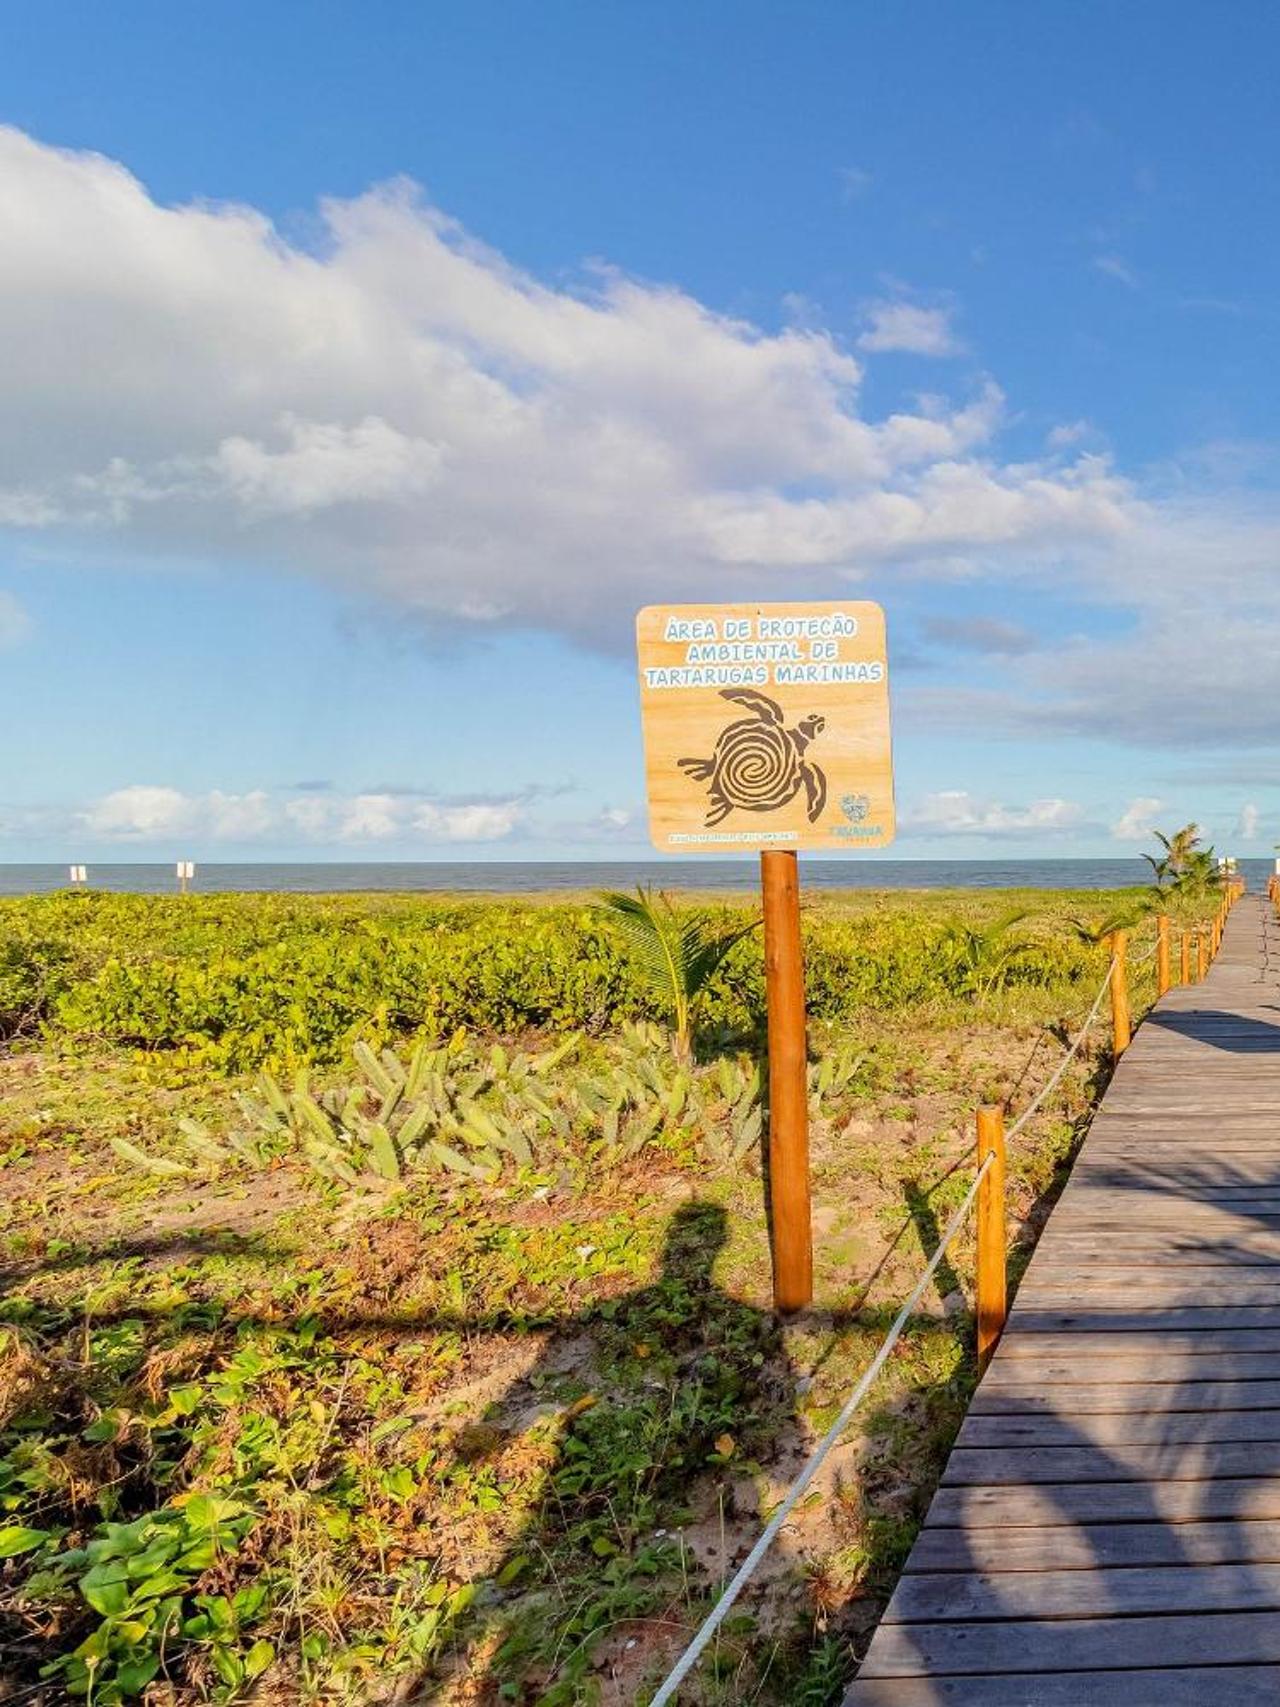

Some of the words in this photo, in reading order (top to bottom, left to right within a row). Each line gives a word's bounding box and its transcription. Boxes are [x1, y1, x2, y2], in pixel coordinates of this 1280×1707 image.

[665, 618, 715, 639] ÁREA
[725, 620, 751, 637] DE
[688, 643, 802, 661] AMBIENTAL
[812, 642, 836, 658] DE
[647, 667, 767, 686] TARTARUGAS
[776, 664, 881, 683] MARINHAS
